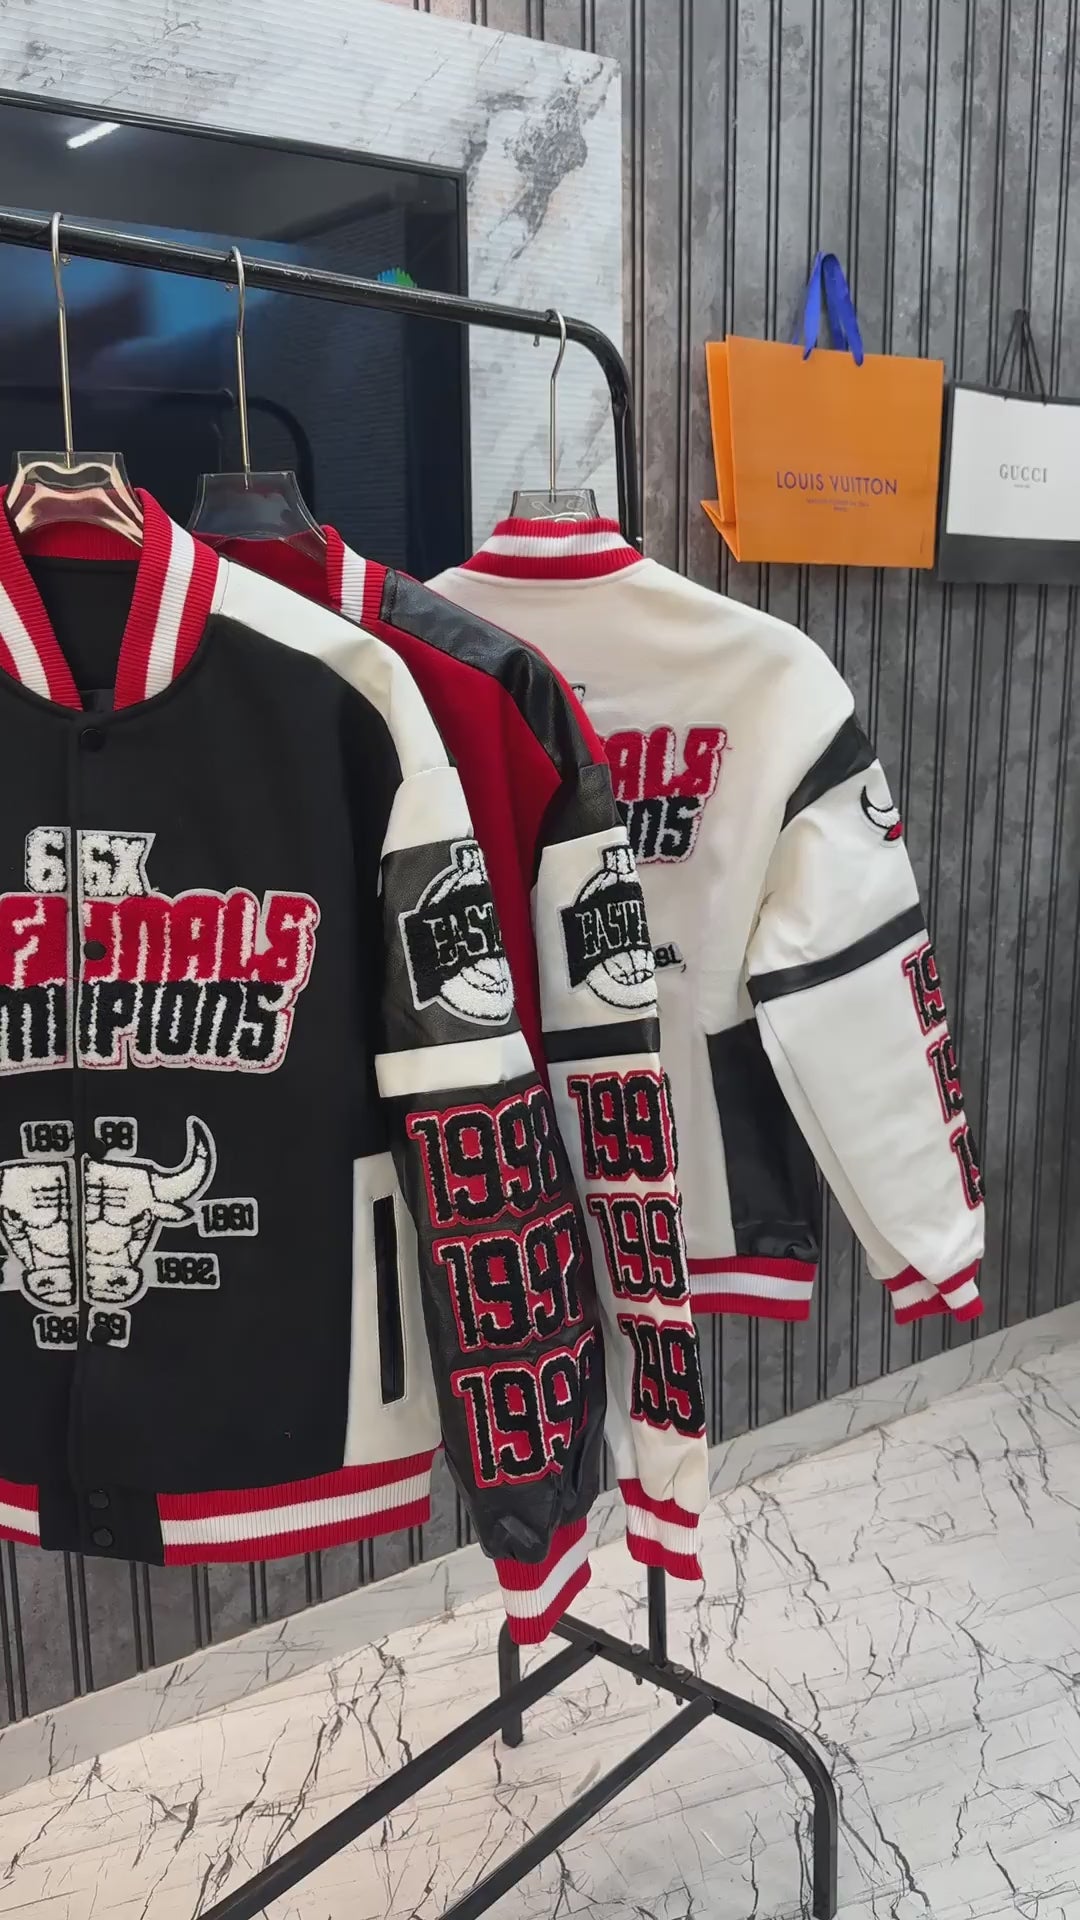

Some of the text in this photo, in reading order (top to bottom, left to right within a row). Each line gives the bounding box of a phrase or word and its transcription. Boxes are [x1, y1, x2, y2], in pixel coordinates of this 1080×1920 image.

[776, 471, 898, 496] LOUIS VUITTON
[999, 463, 1047, 483] GUCCI
[409, 1087, 561, 1227] 1998
[569, 1071, 678, 1179] 199
[435, 1206, 584, 1350] 1997
[592, 1194, 690, 1302] 199
[621, 1316, 706, 1434] 199
